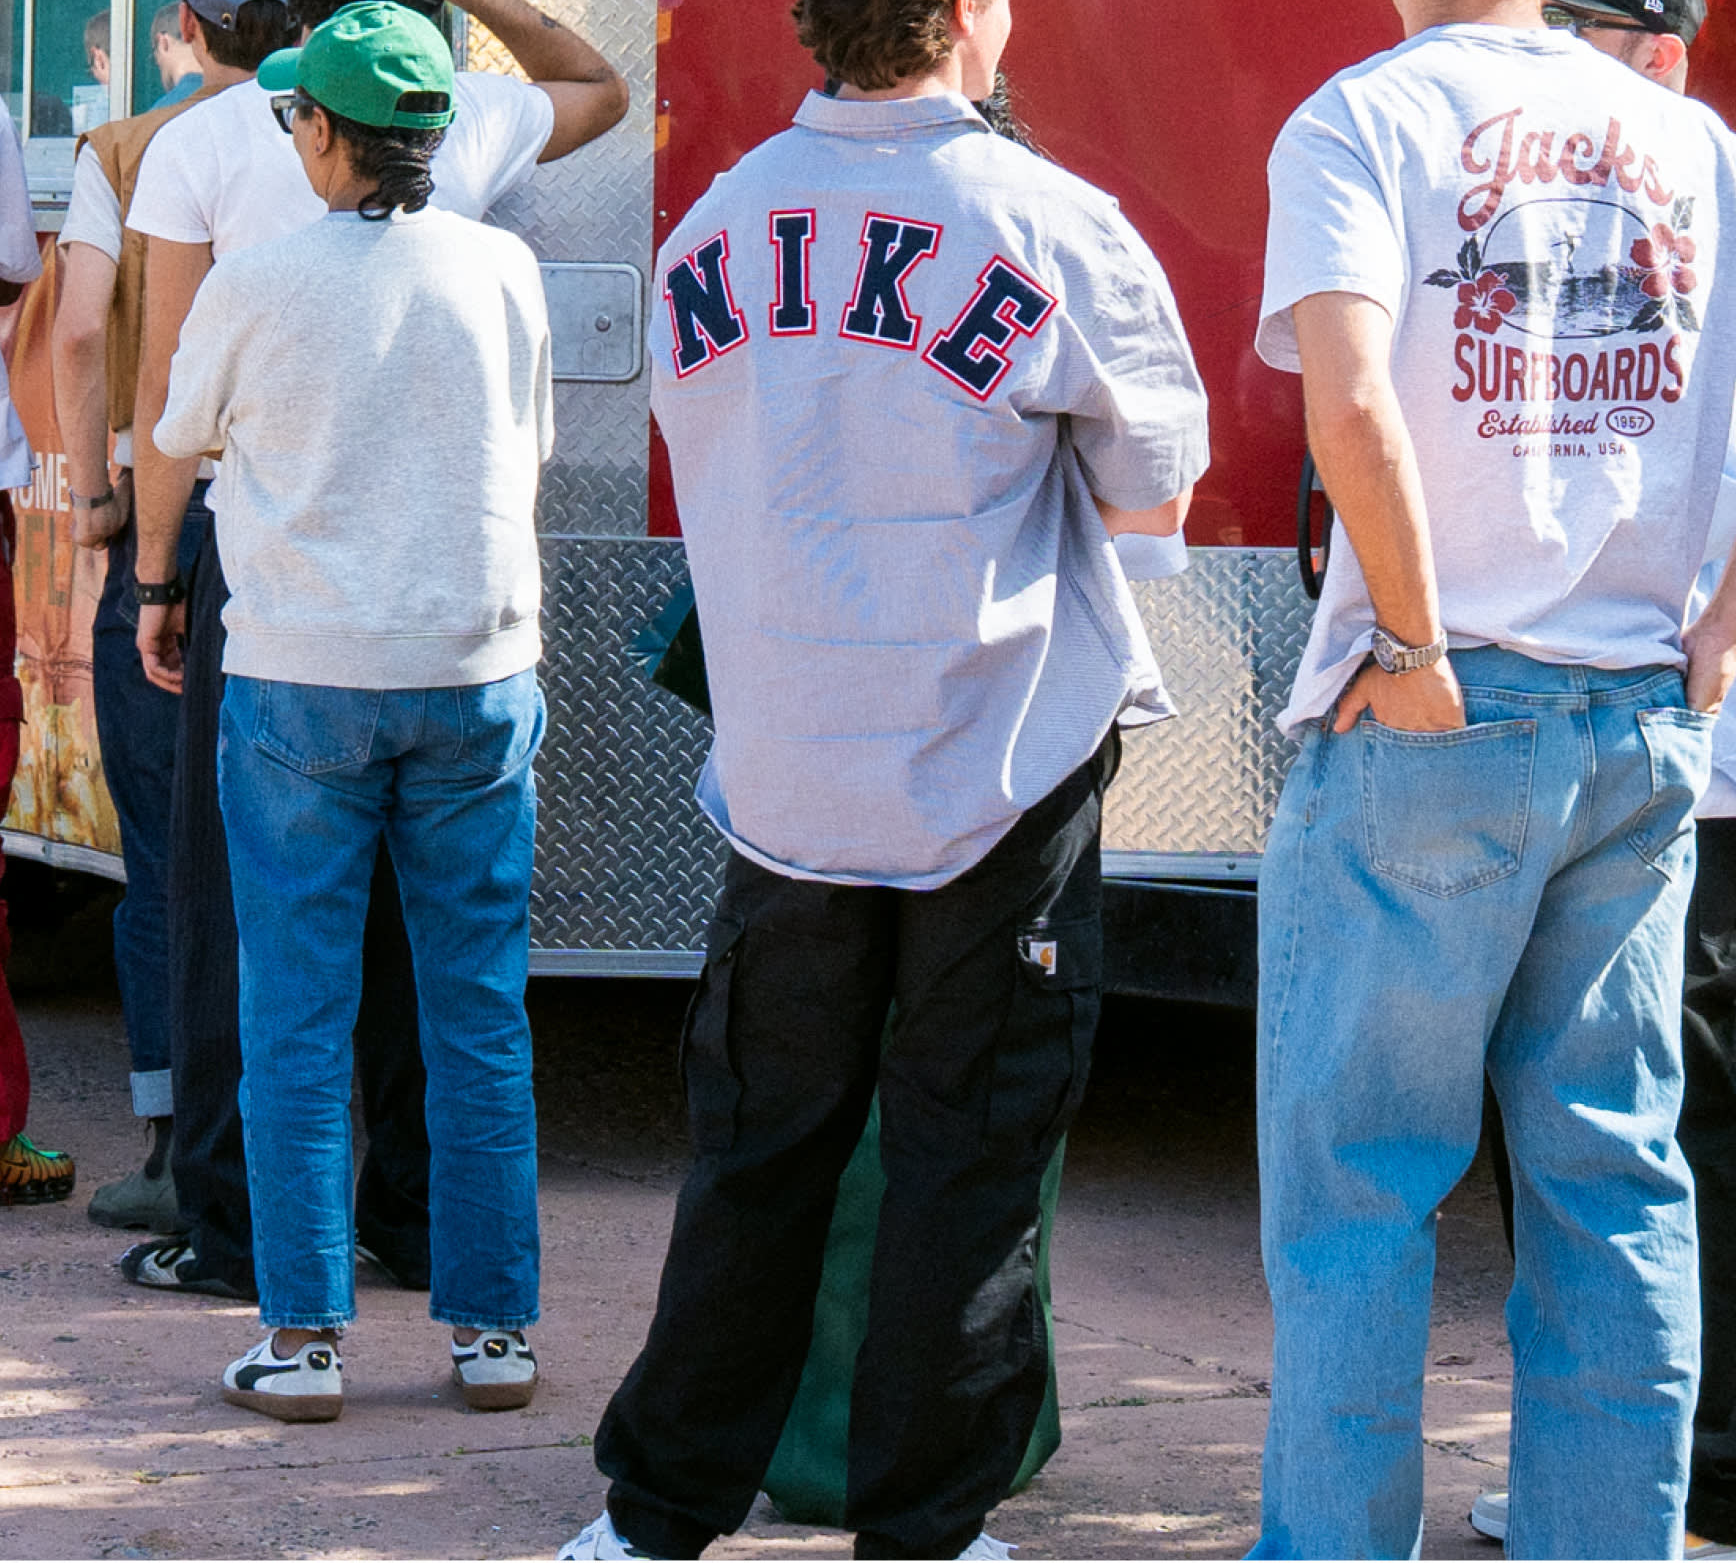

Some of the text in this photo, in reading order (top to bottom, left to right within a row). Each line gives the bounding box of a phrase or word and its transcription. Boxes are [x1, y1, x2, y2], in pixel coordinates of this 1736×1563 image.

[1457, 106, 1674, 232] Jacks
[663, 208, 1059, 402] NIKE
[1451, 333, 1684, 404] SURFBOARDS
[1477, 408, 1645, 439] Established 1957
[1598, 443, 1627, 456] USA
